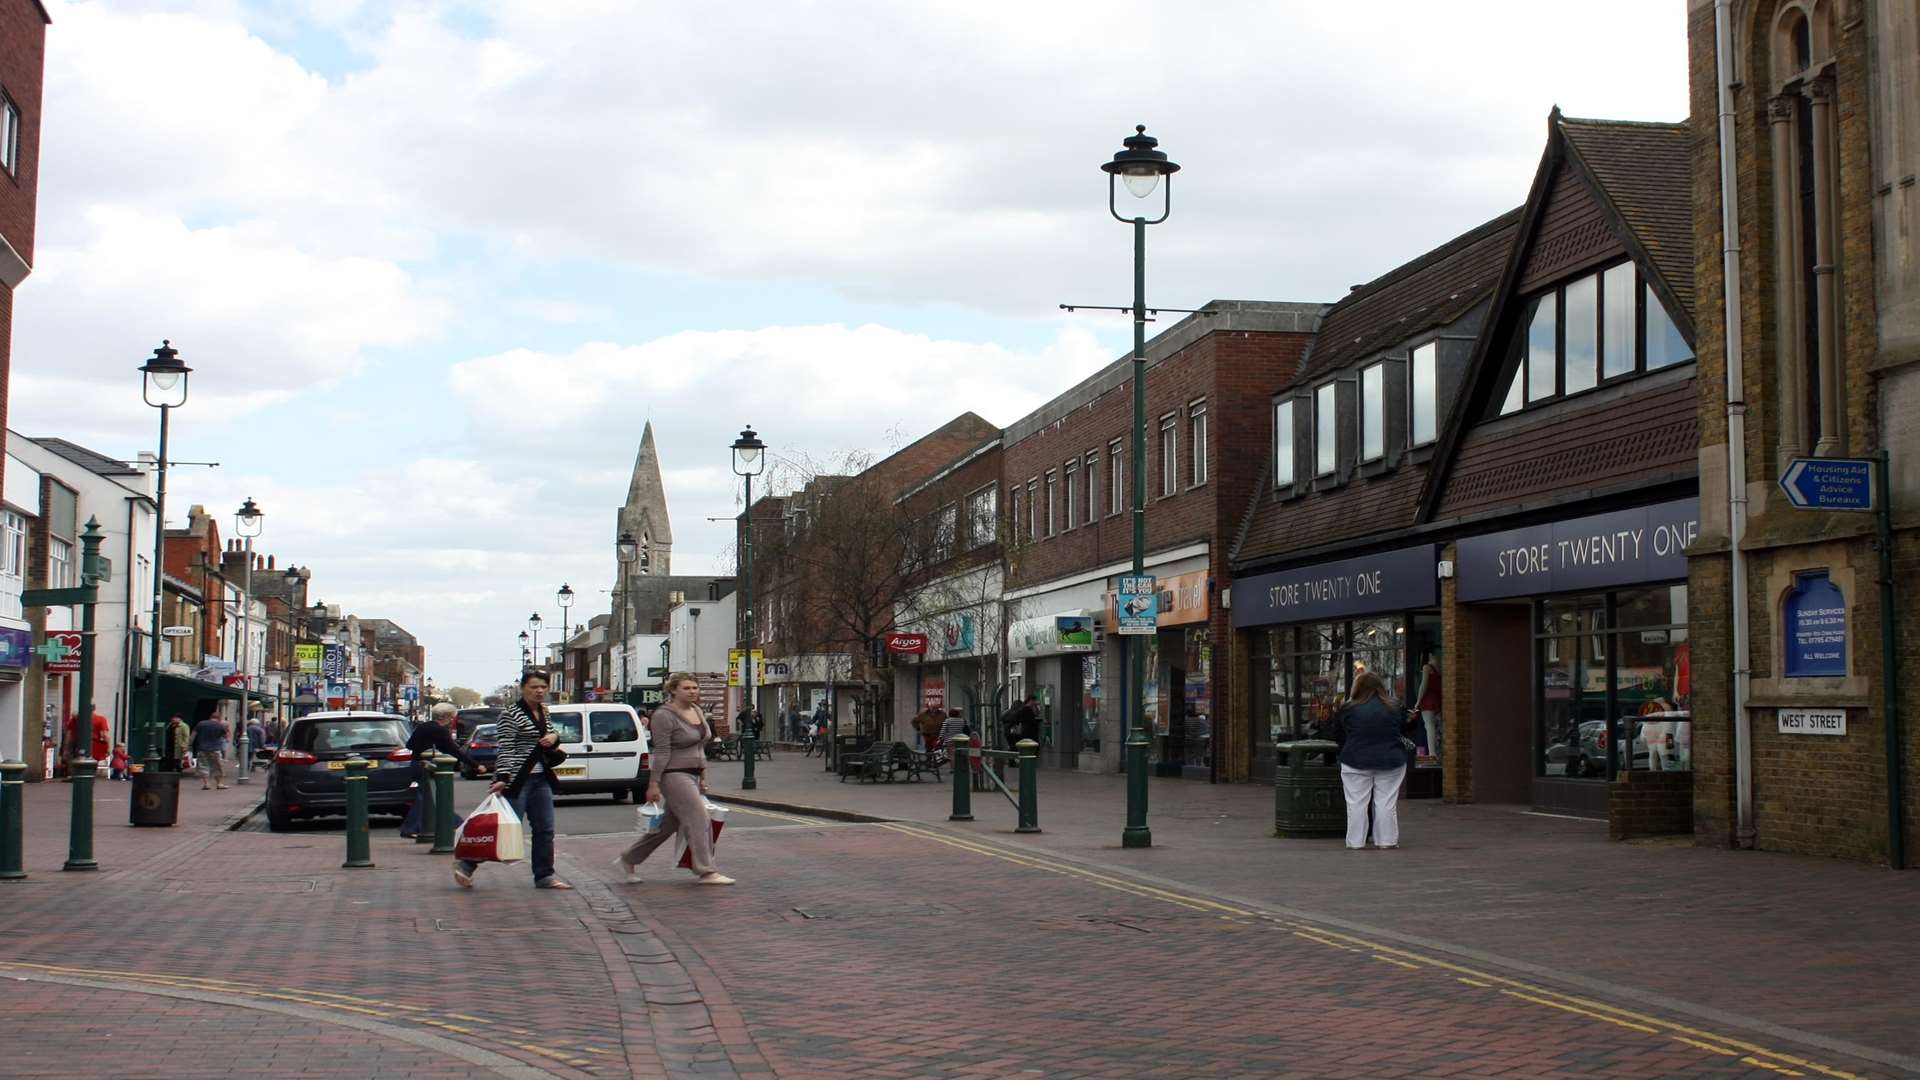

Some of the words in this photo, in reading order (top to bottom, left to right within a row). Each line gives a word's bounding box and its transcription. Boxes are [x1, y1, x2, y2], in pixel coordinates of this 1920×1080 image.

[1808, 464, 1848, 475] Housing
[1850, 466, 1867, 475] Aid
[1822, 475, 1862, 484] Citizens
[1820, 484, 1853, 493] Advice
[1819, 494, 1860, 504] Bureaux
[1497, 543, 1549, 577] STORE
[1558, 528, 1644, 569] TWENTY
[1653, 520, 1697, 556] ONE
[1269, 583, 1299, 608] STORE
[1304, 575, 1352, 603] TWENTY
[1356, 570, 1381, 597] ONE
[890, 637, 921, 647] Argos
[1781, 714, 1806, 728] WEST
[1809, 714, 1842, 729] STREET
